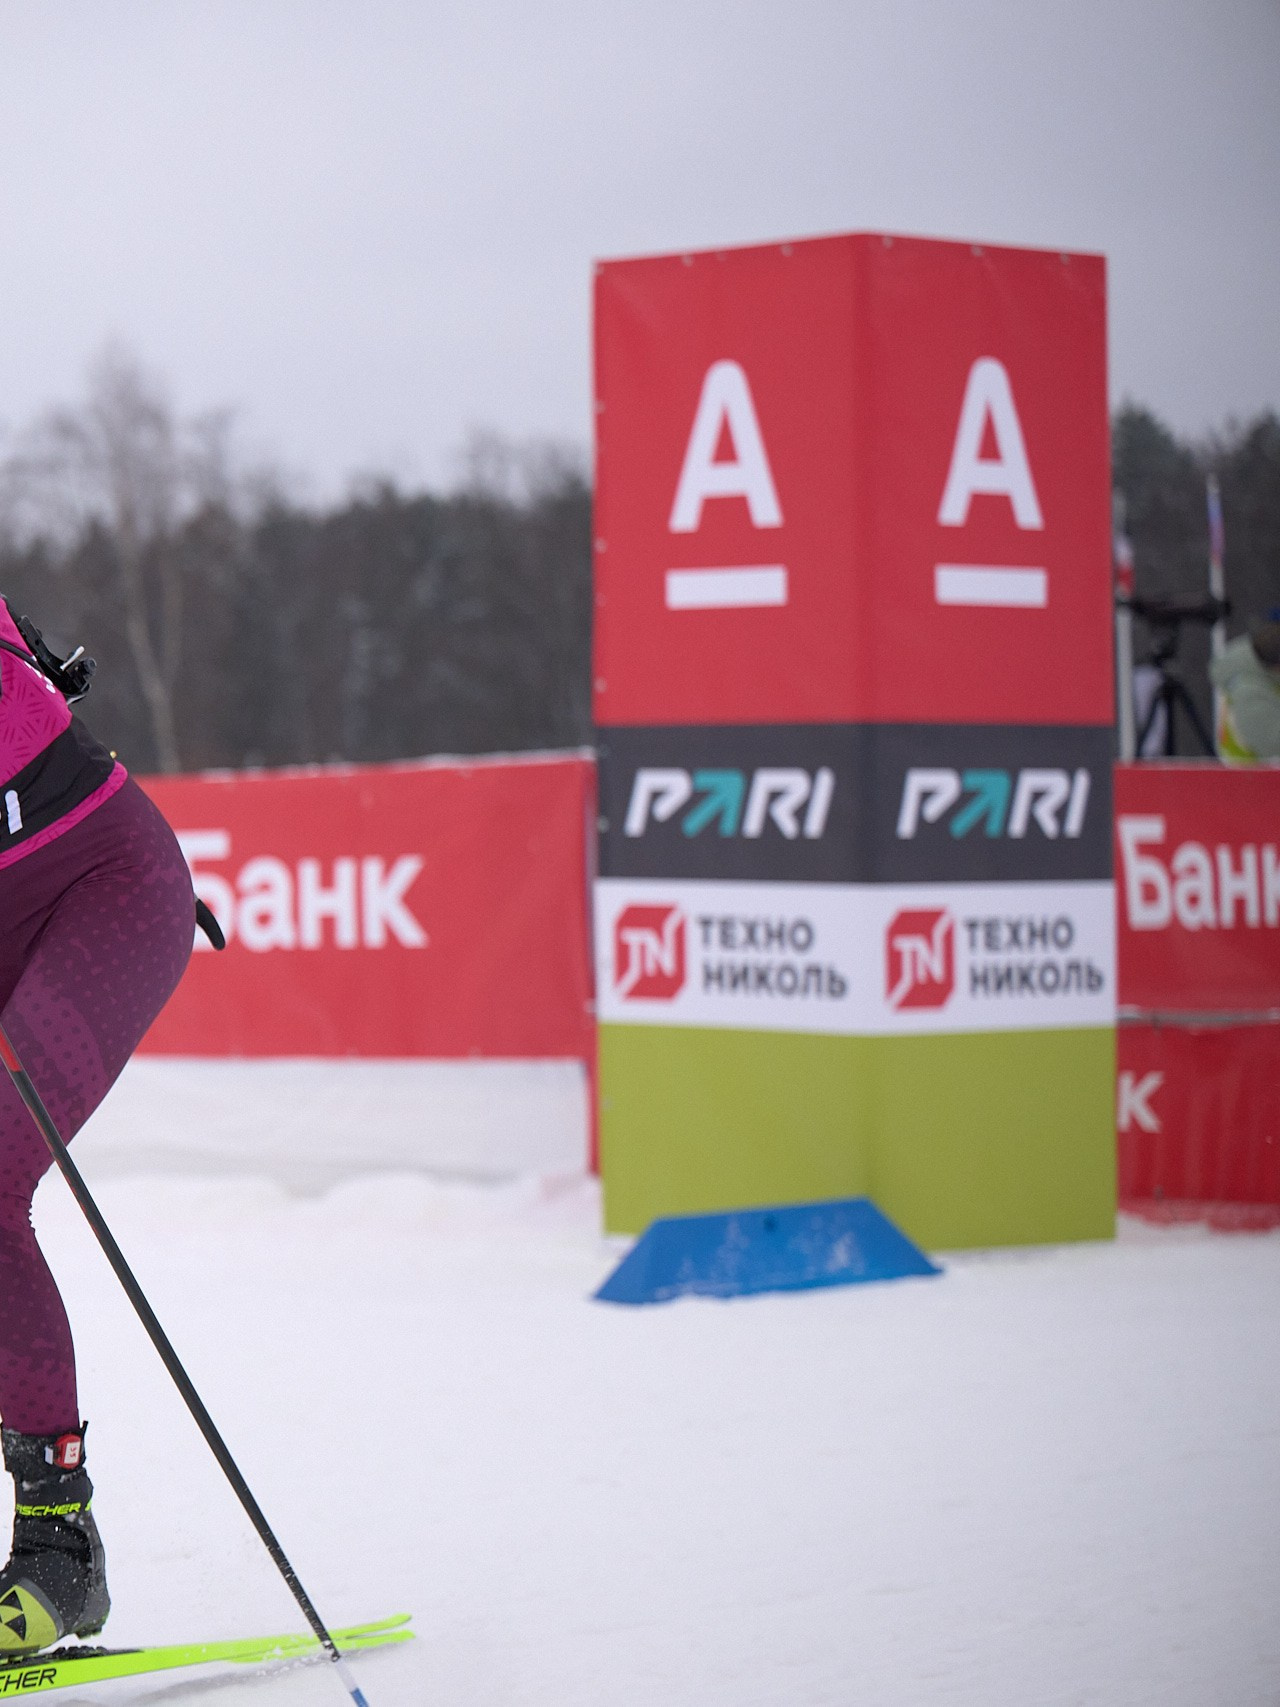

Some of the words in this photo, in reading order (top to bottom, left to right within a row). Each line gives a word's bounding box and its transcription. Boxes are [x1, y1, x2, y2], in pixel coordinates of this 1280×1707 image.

[625, 766, 836, 839] PARI
[896, 766, 1091, 839] PARI
[698, 915, 815, 954] ТЕХНО
[964, 915, 1074, 951] ТЕХНО
[703, 962, 847, 998] НИКОЛЬ
[969, 960, 1104, 996] НИКОЛЬ
